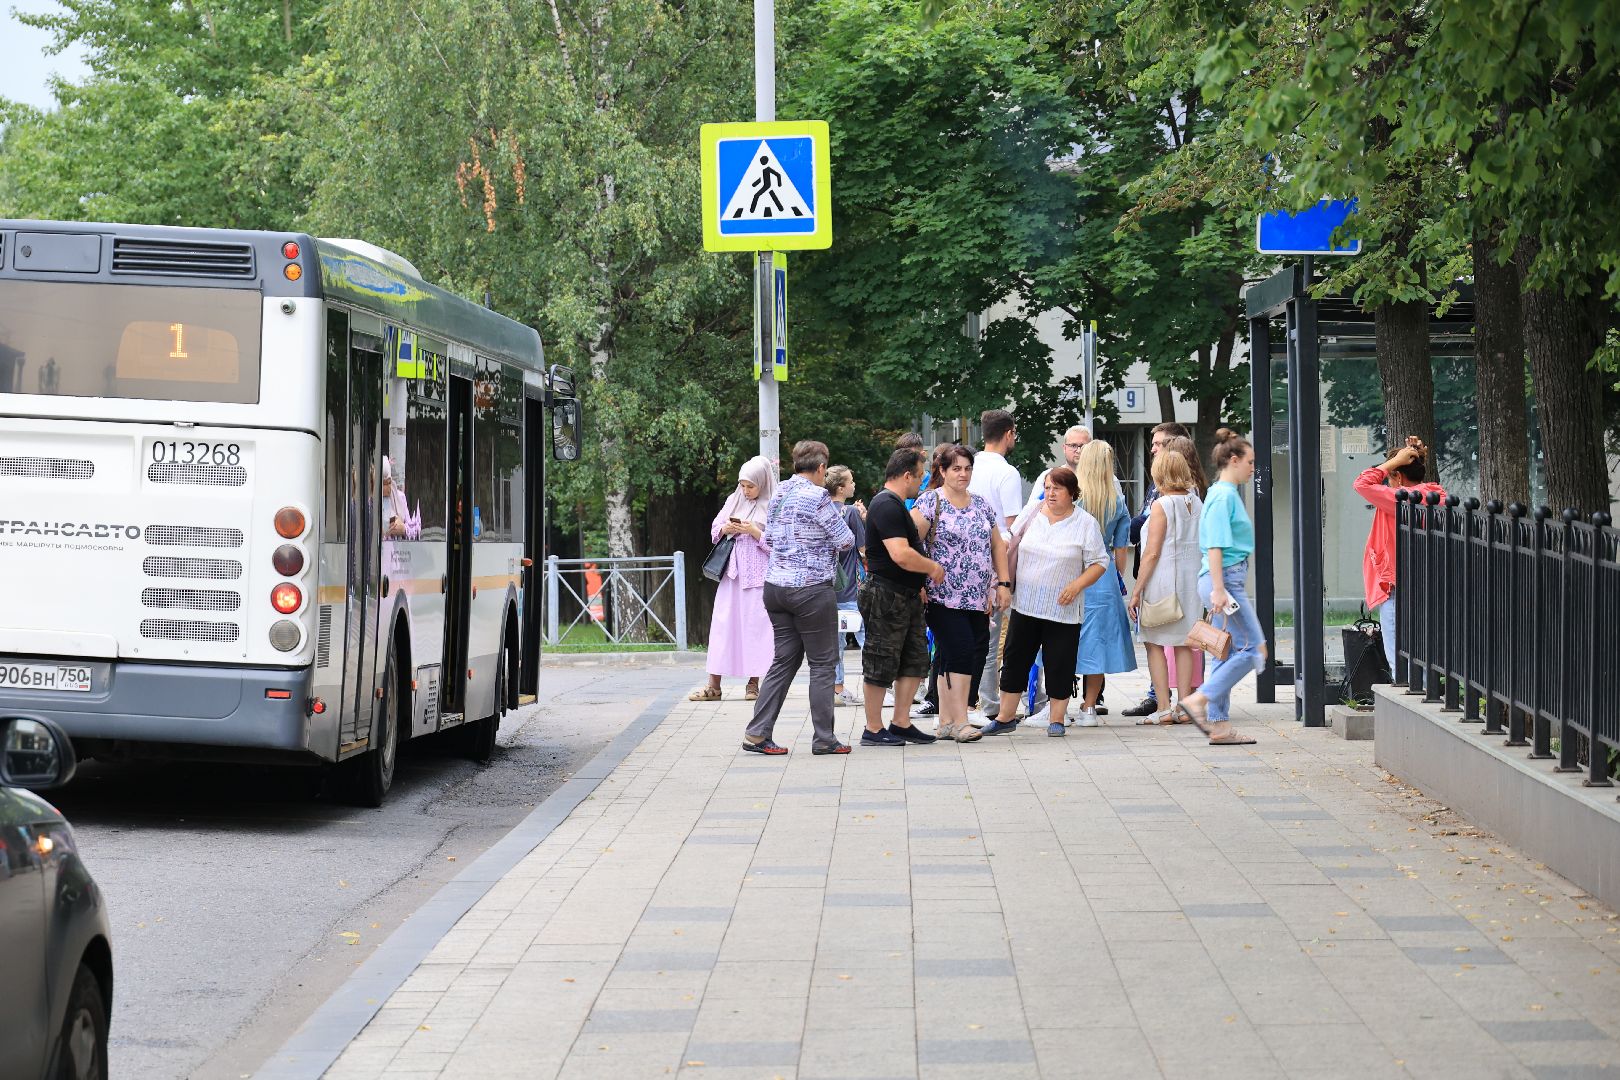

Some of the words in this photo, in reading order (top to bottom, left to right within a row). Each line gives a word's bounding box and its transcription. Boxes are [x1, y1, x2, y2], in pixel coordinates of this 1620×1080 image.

[170, 323, 188, 358] 1
[1126, 390, 1136, 408] 9
[152, 440, 241, 466] 013268
[59, 668, 86, 683] 750
